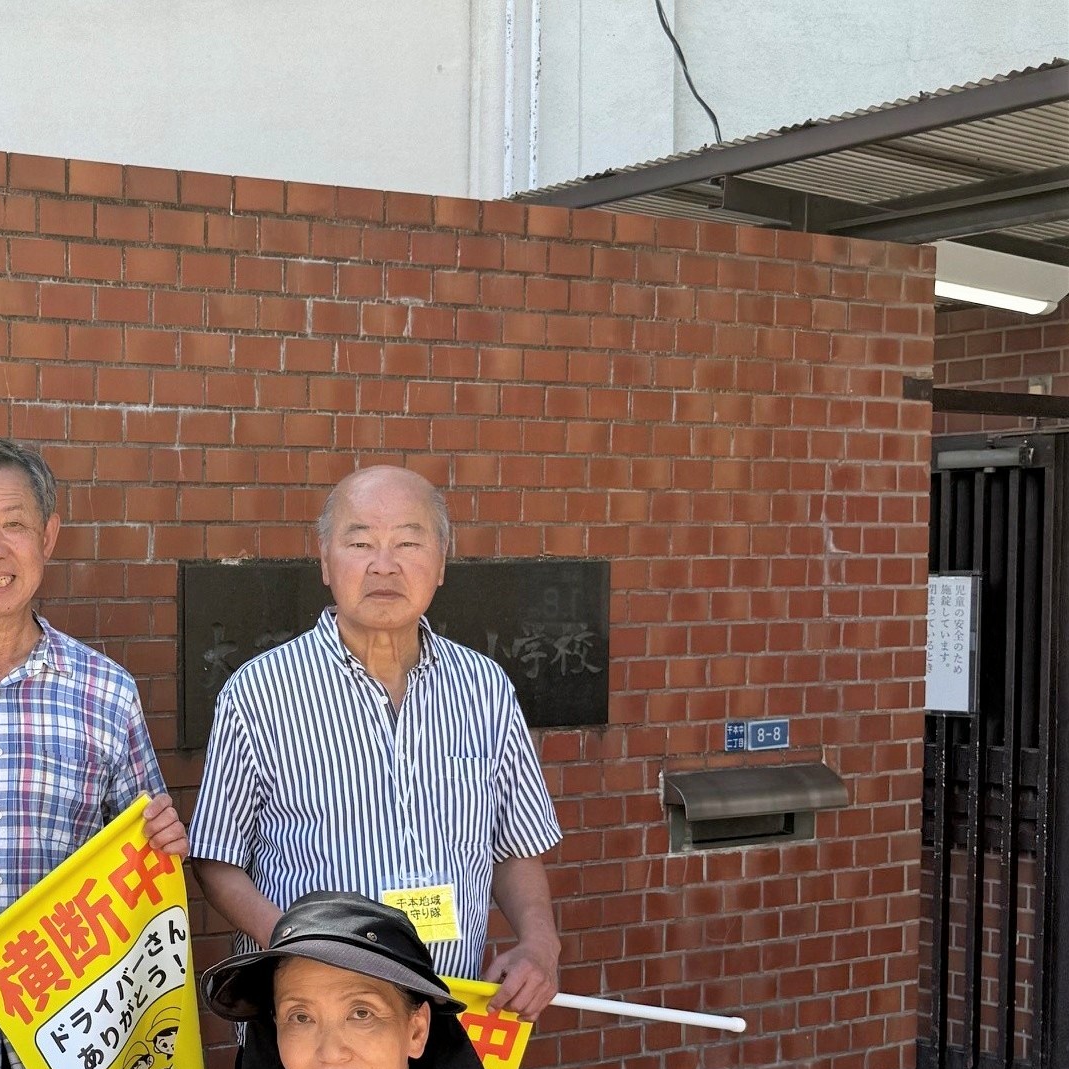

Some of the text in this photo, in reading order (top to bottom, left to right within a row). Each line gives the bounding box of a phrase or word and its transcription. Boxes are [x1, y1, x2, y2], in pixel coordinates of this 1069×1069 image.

[952, 584, 966, 675] 児童の安全のため
[757, 727, 781, 743] 8-8
[727, 738, 744, 749] 二丁目
[396, 895, 441, 909] 千本地域
[406, 907, 442, 920] 守り隊
[50, 920, 187, 1054] ドライバーさん
